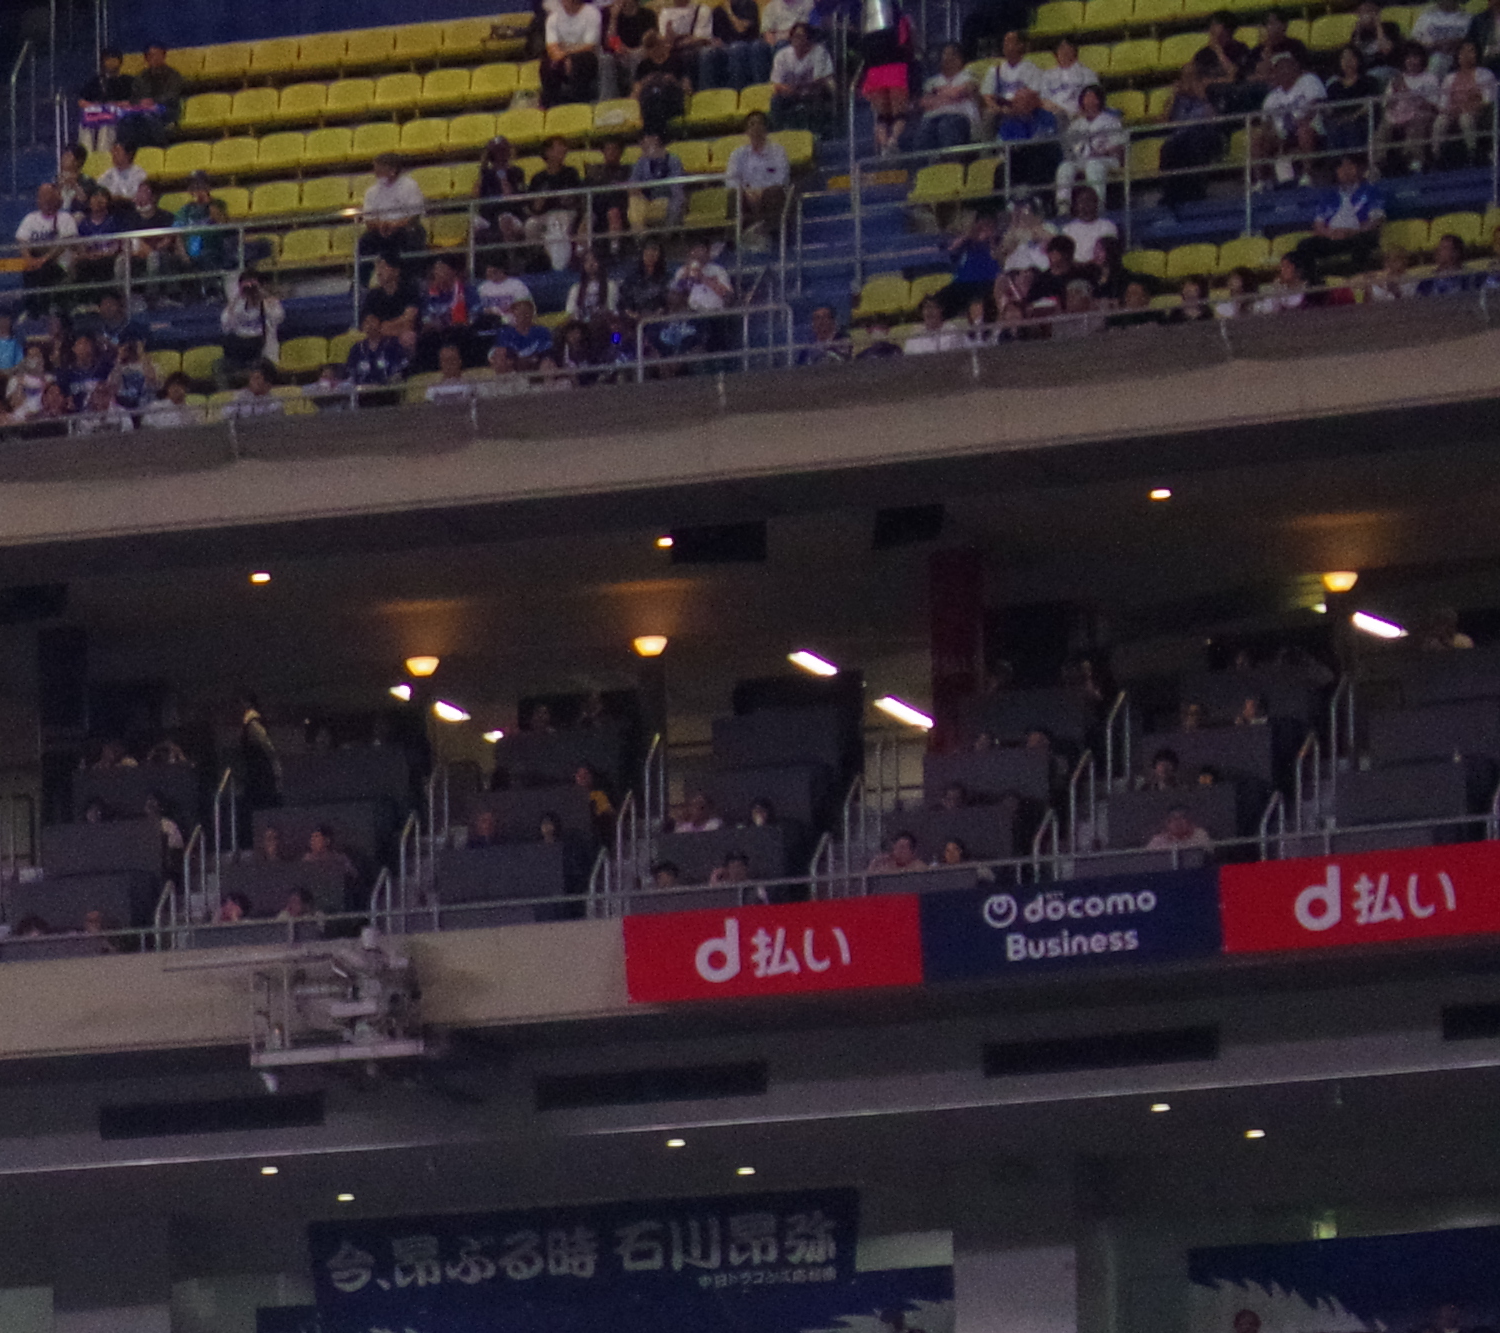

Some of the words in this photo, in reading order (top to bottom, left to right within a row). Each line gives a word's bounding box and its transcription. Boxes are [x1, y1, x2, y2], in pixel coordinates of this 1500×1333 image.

[1023, 888, 1158, 923] docomo
[1293, 866, 1459, 933] d払い
[694, 917, 852, 984] d払い
[1006, 927, 1140, 964] Business
